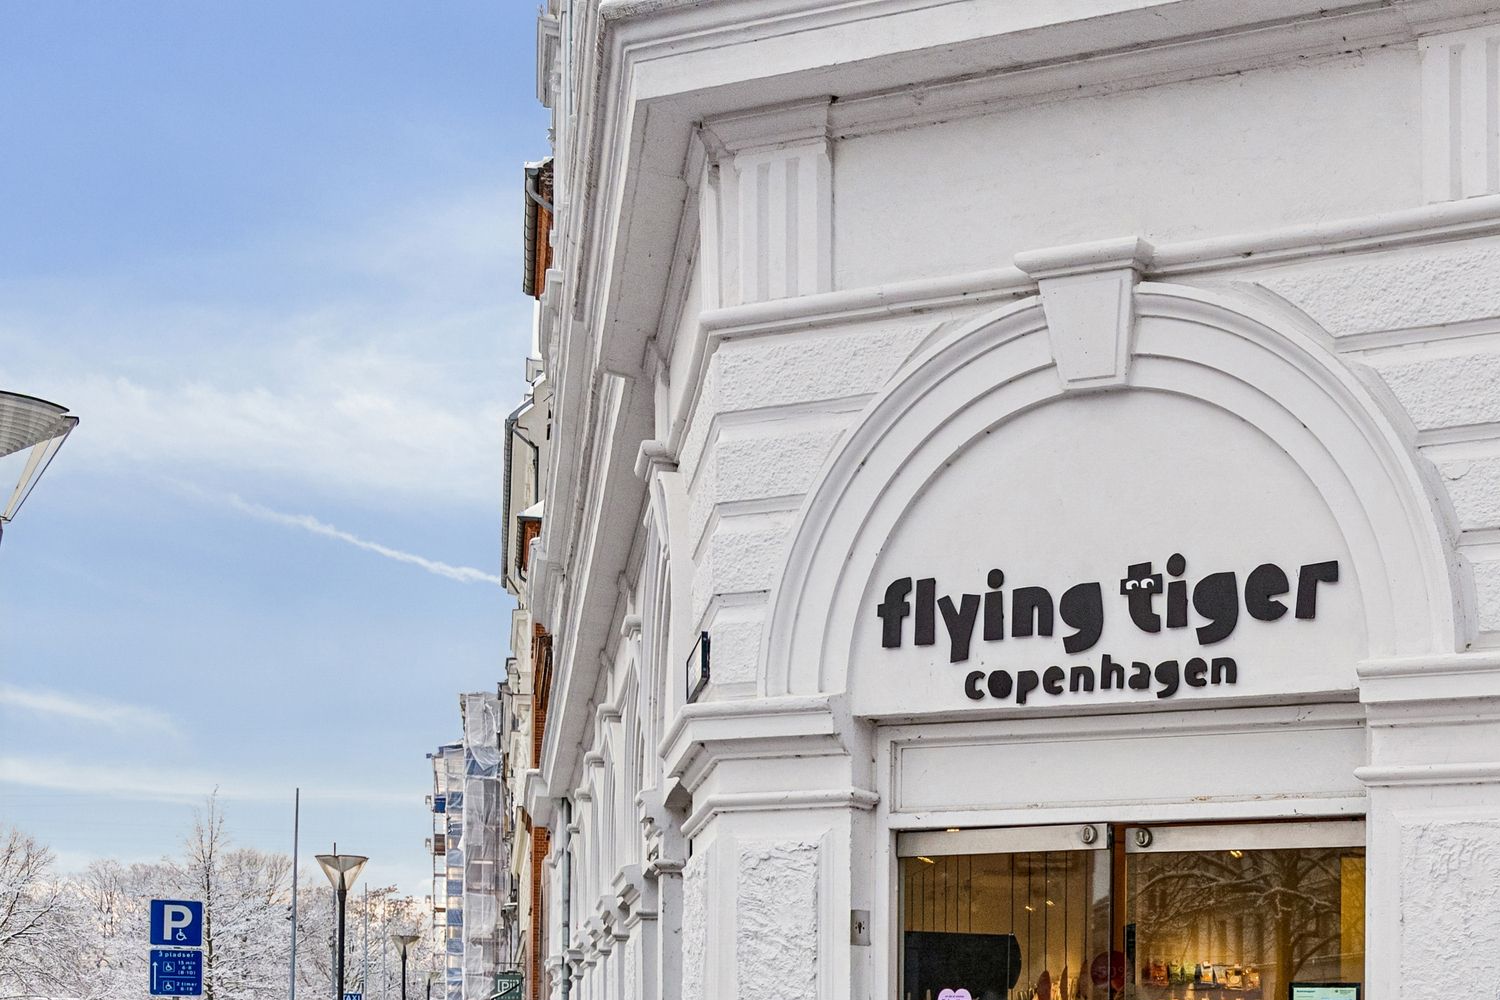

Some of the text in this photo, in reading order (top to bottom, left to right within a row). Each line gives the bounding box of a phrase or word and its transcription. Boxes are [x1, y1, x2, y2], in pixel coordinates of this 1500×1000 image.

[877, 552, 1339, 663] flying tiger
[964, 653, 1238, 704] copenhagen
[163, 904, 193, 940] P
